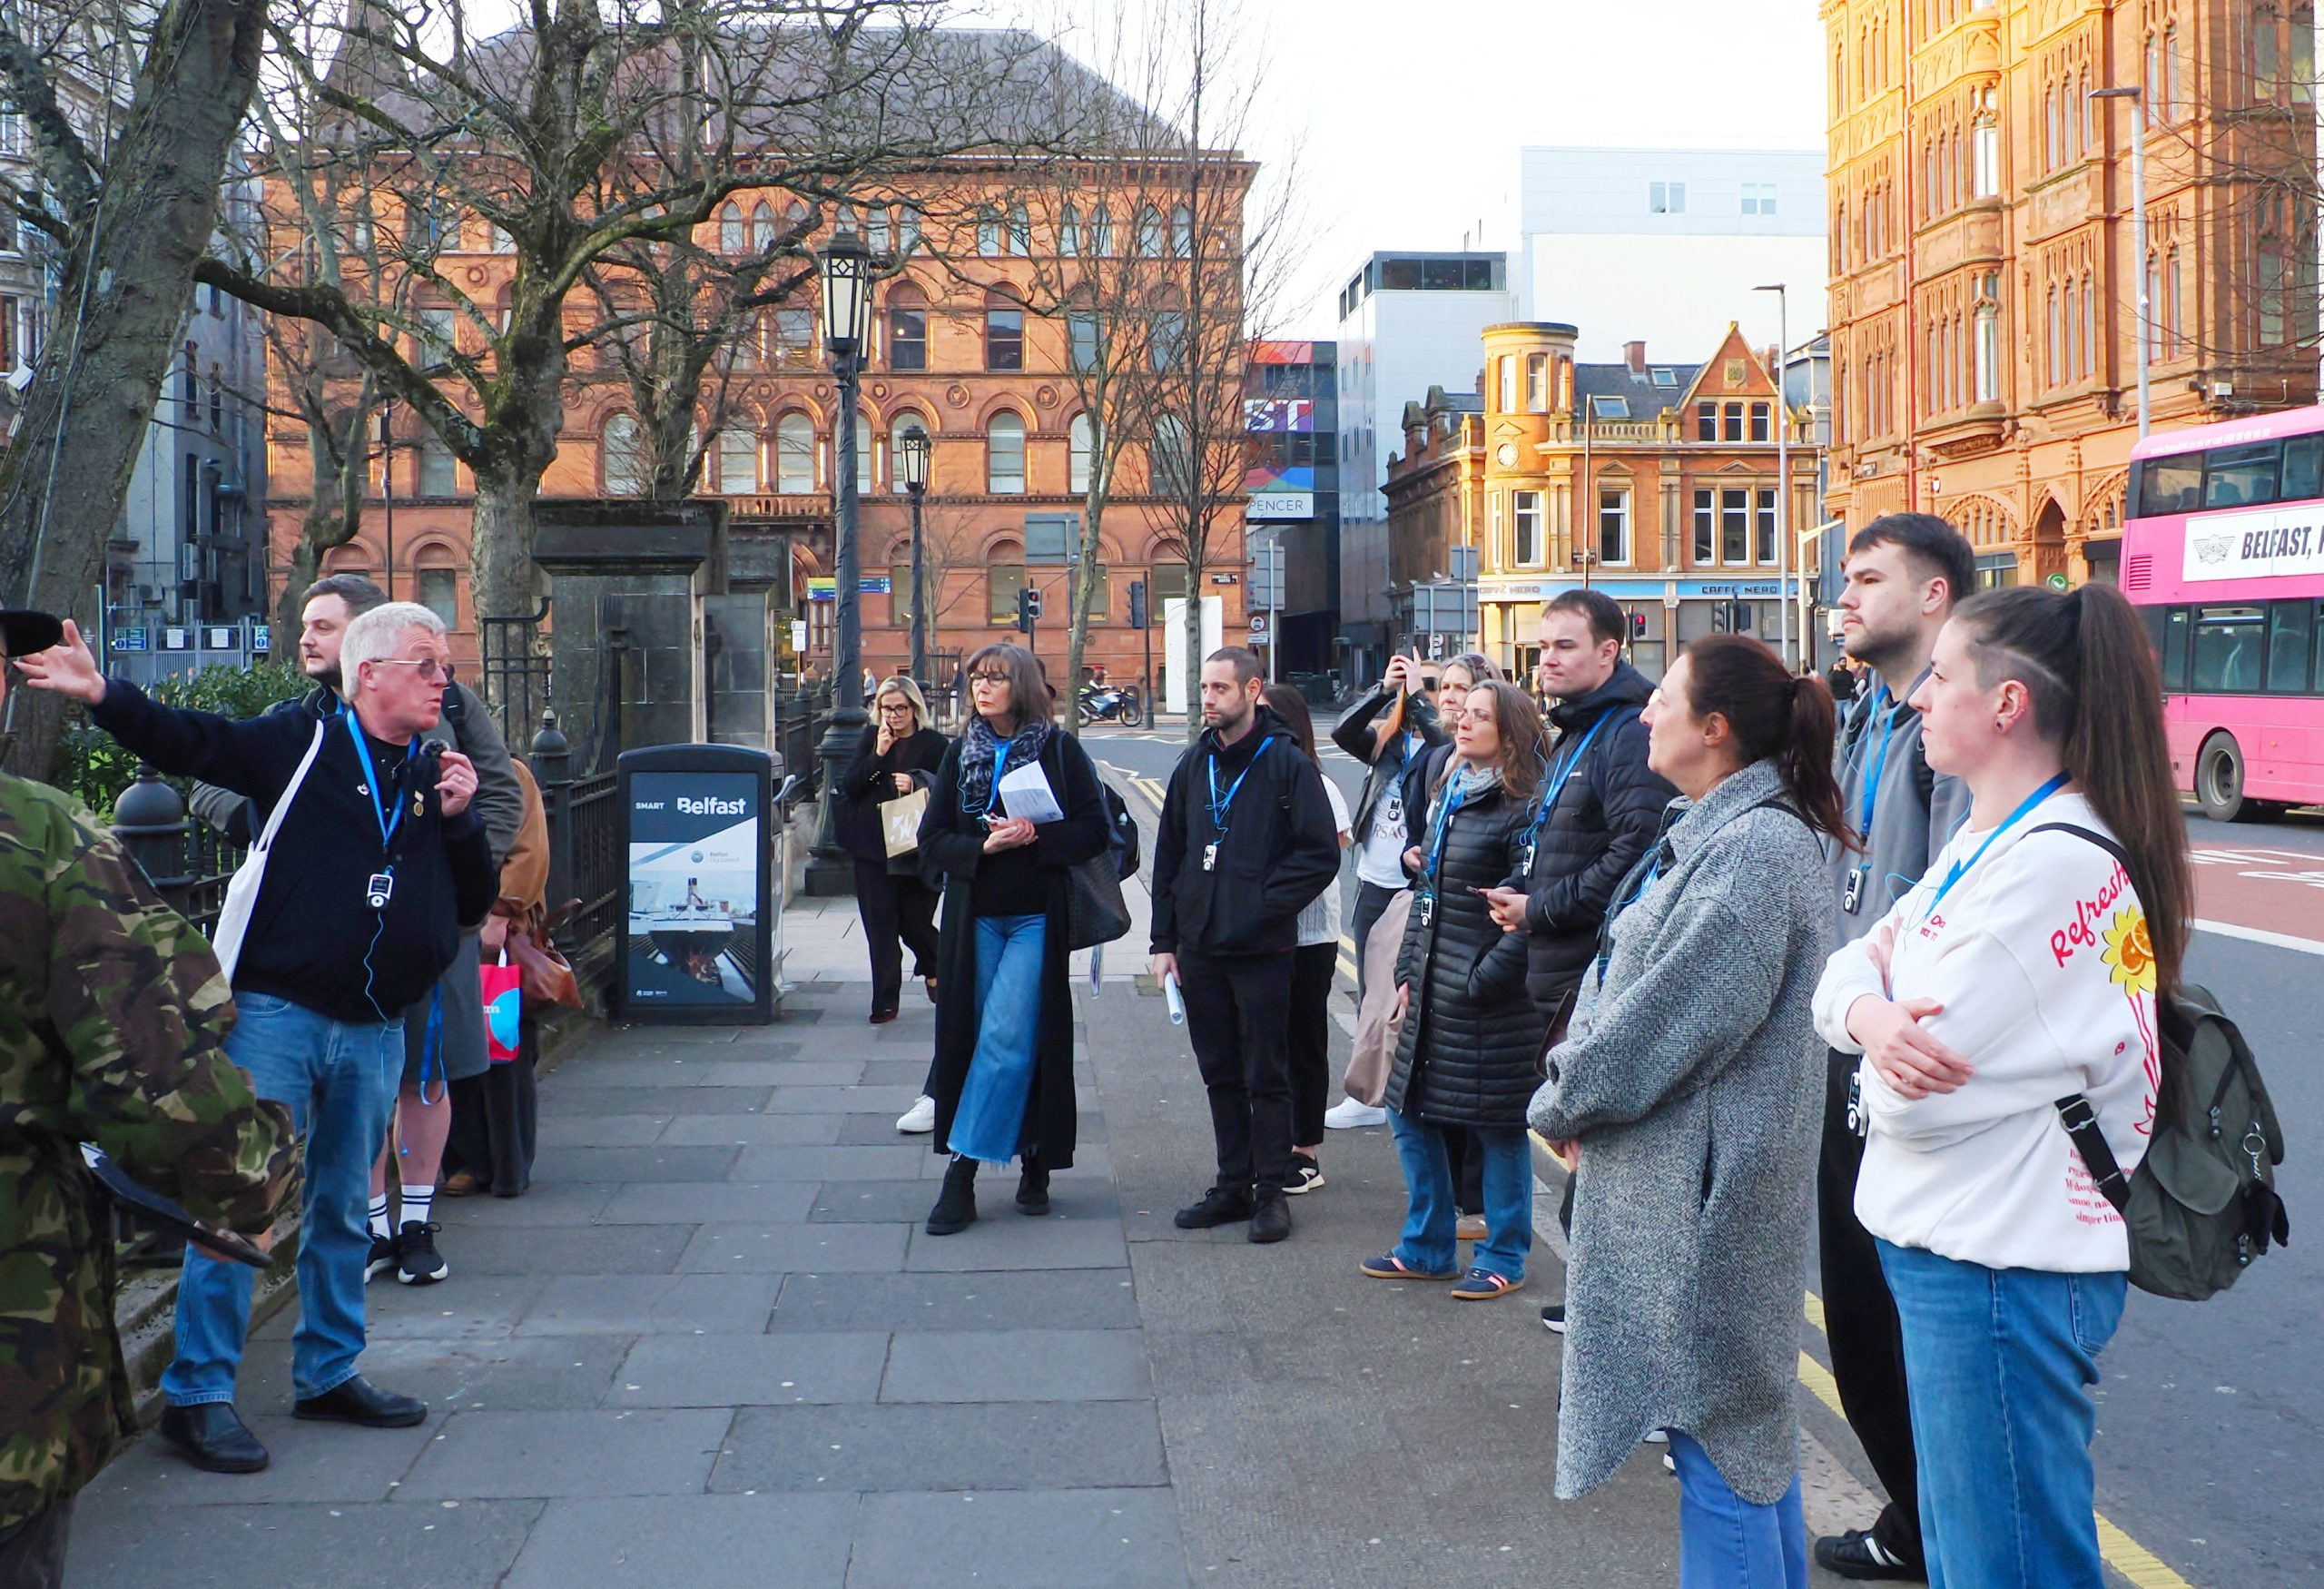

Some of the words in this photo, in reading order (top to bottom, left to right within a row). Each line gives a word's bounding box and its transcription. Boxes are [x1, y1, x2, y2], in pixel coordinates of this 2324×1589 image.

[1248, 500, 1304, 511] PENCER
[2240, 526, 2312, 560] BELFAST,
[1744, 586, 1777, 594] NERO
[635, 802, 665, 810] SMART
[676, 796, 746, 814] Belfast
[1374, 823, 1407, 839] RSAC
[2051, 859, 2130, 968] Refresh
